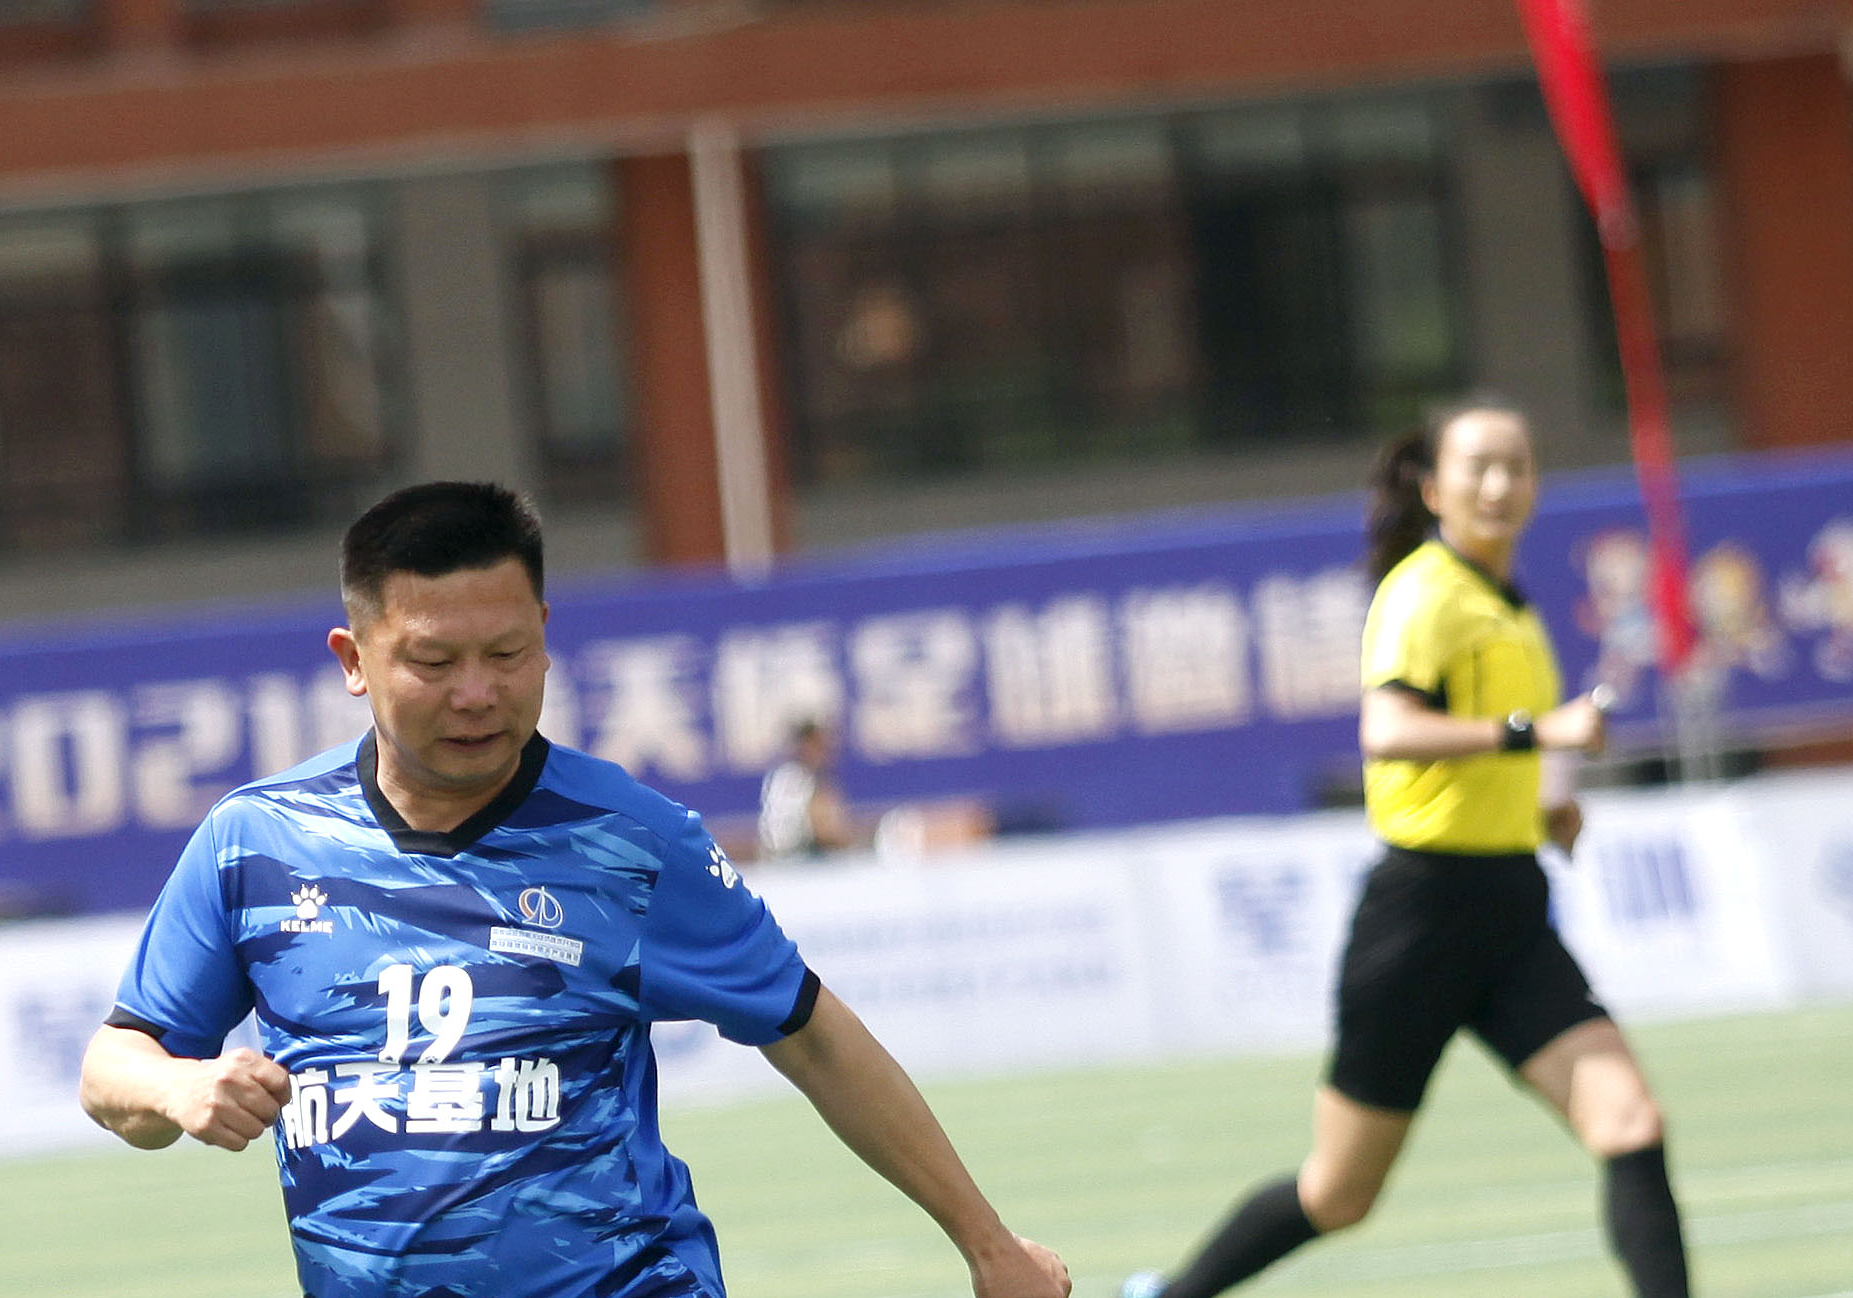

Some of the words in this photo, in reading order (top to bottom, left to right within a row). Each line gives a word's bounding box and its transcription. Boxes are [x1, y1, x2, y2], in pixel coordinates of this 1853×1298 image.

[280, 920, 333, 934] KELME
[377, 963, 473, 1065] 19
[281, 1056, 561, 1150] 航天基地
